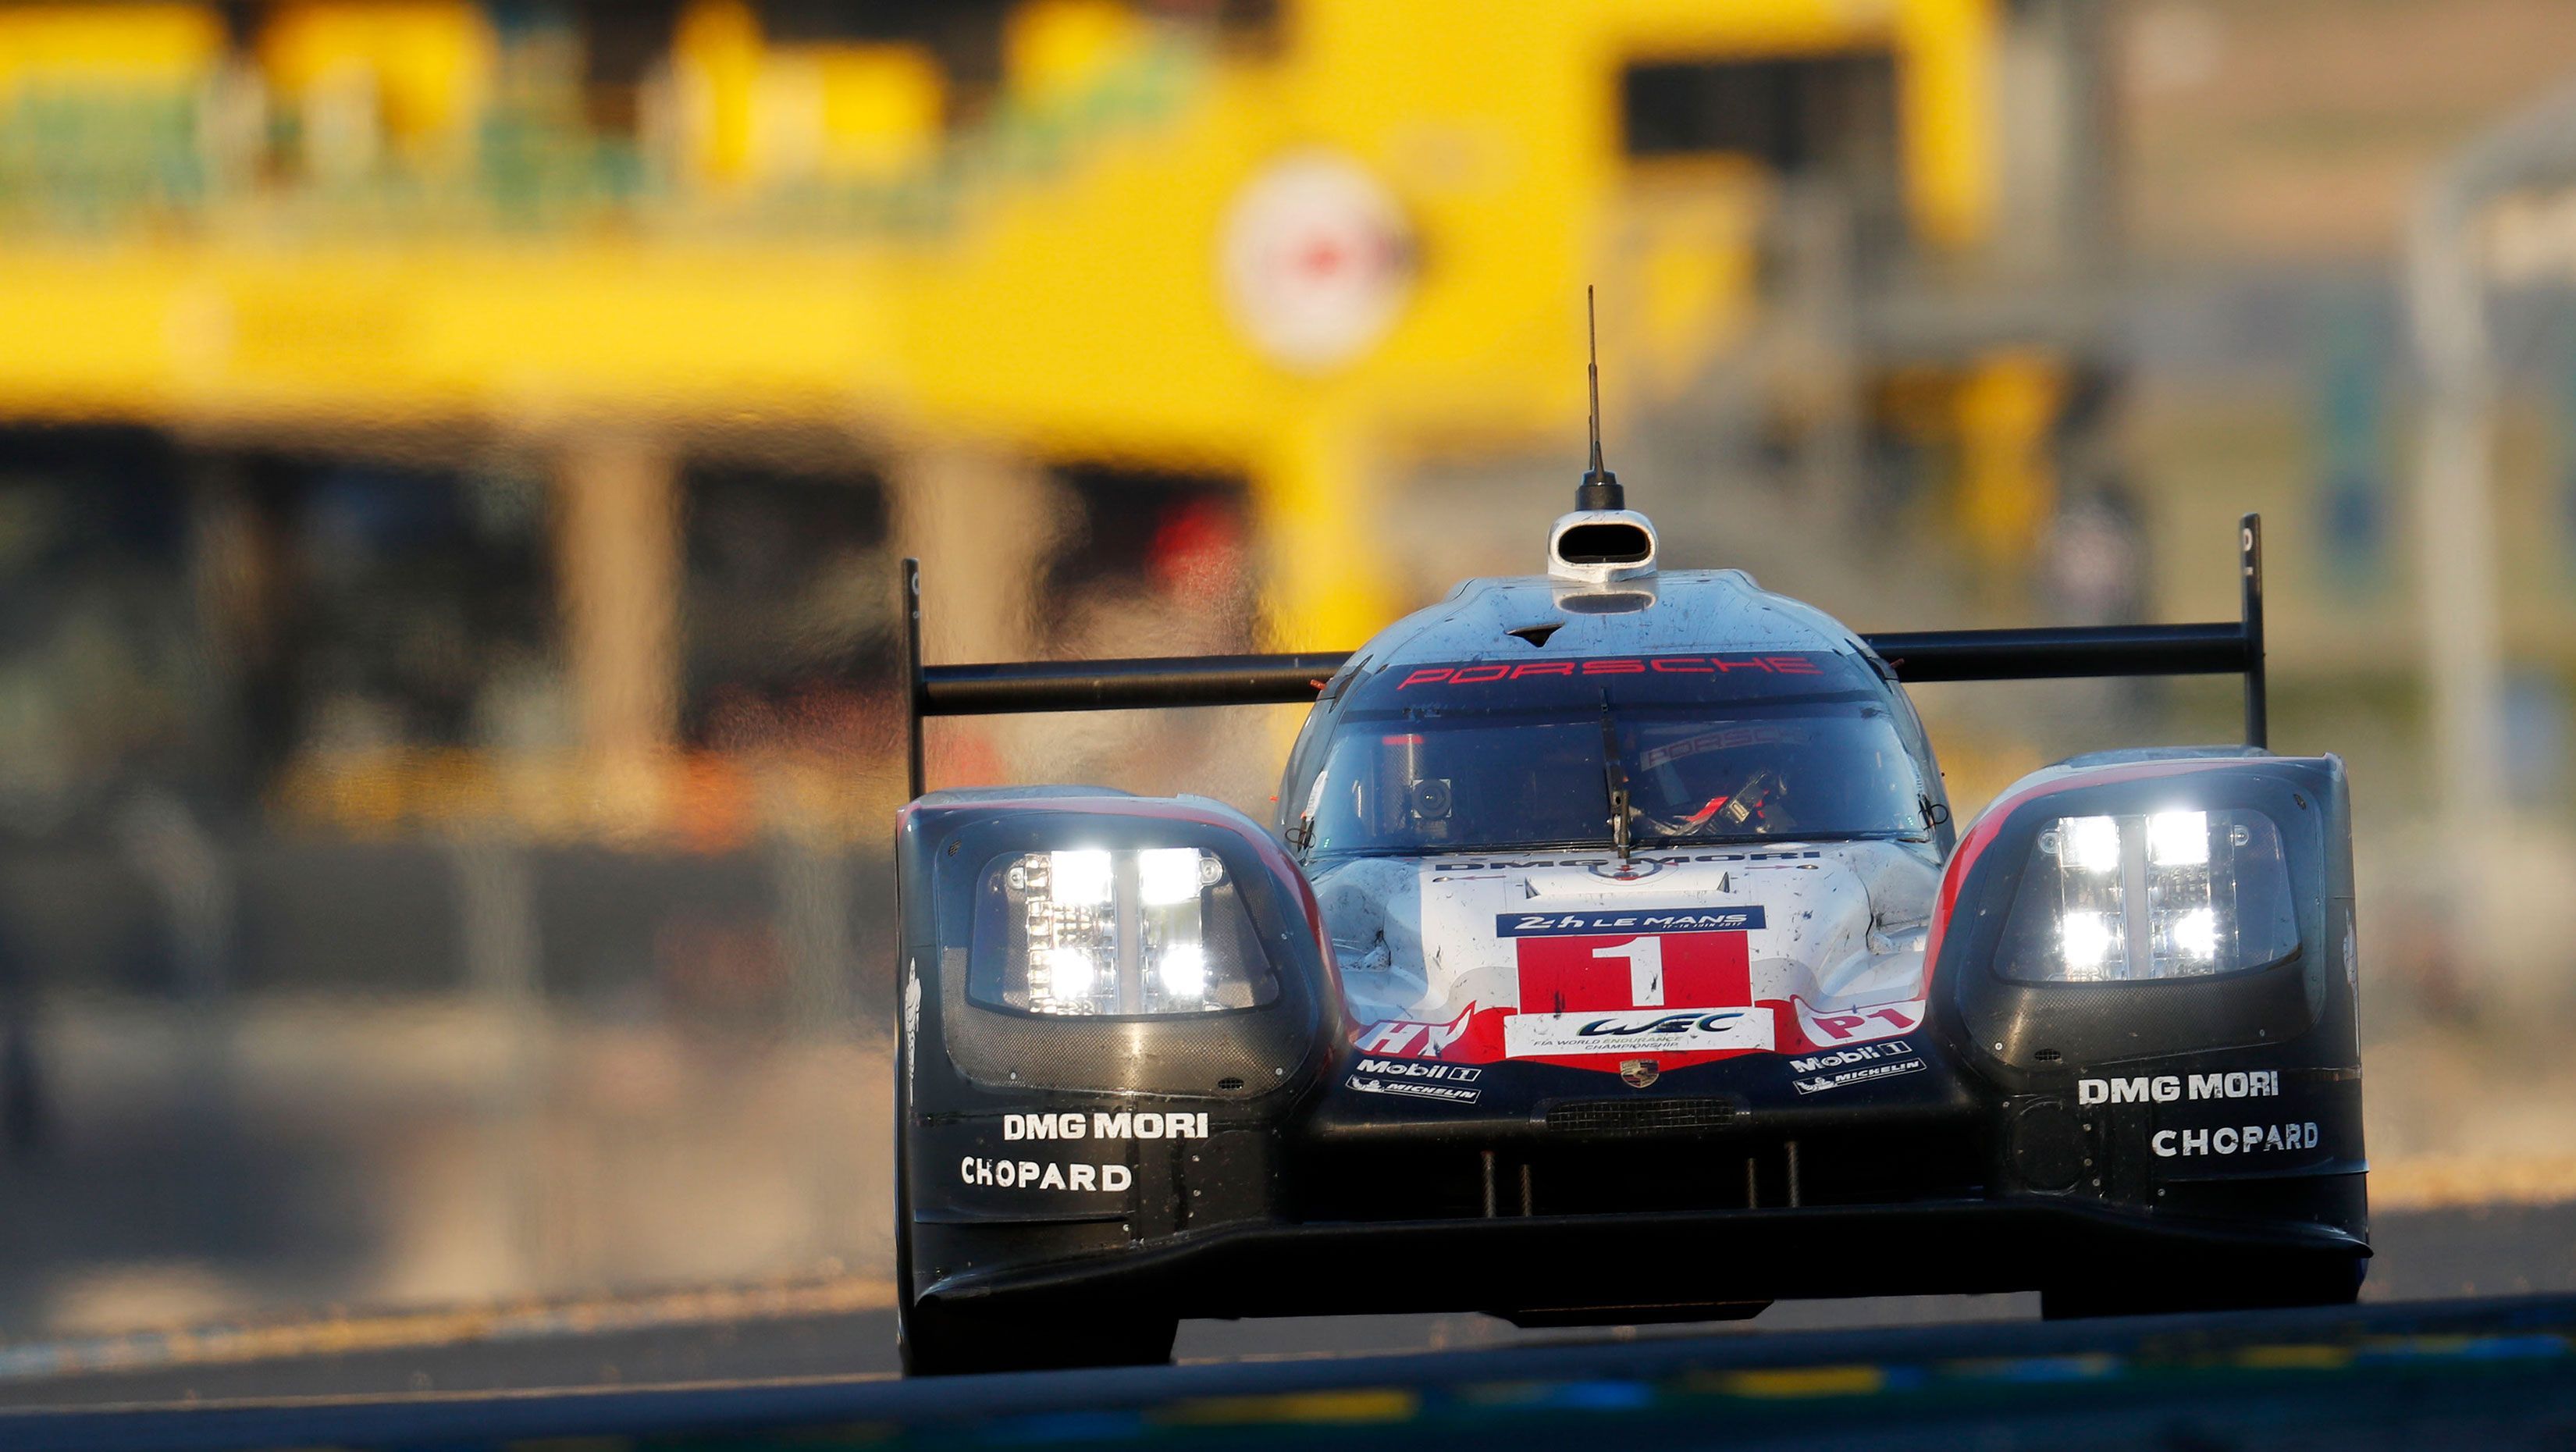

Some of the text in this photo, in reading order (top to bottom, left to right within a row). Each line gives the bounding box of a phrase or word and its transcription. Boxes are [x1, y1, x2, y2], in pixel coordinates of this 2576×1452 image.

[1397, 657, 1823, 690] PORSCHE
[1435, 851, 1820, 871] DMG MORI
[1592, 917, 1638, 927] LE
[1643, 913, 1748, 926] MANS
[1592, 936, 1664, 1007] 1
[1354, 1009, 1472, 1057] HY
[1578, 1012, 1745, 1037] WEC
[1813, 1008, 1916, 1040] P1
[1585, 1041, 1679, 1051] CHAMPIONSHIP
[1789, 1045, 1881, 1073] Mobil
[1356, 1059, 1449, 1078] Mobil
[1834, 1060, 1920, 1082] MICHELIN
[1385, 1083, 1477, 1098] MICHELIN
[2078, 1071, 2279, 1105] DMG MORI
[1004, 1112, 1209, 1141] DMG MORI
[2151, 1122, 2319, 1157] CHOPARD
[961, 1156, 1133, 1192] CHOPARD
